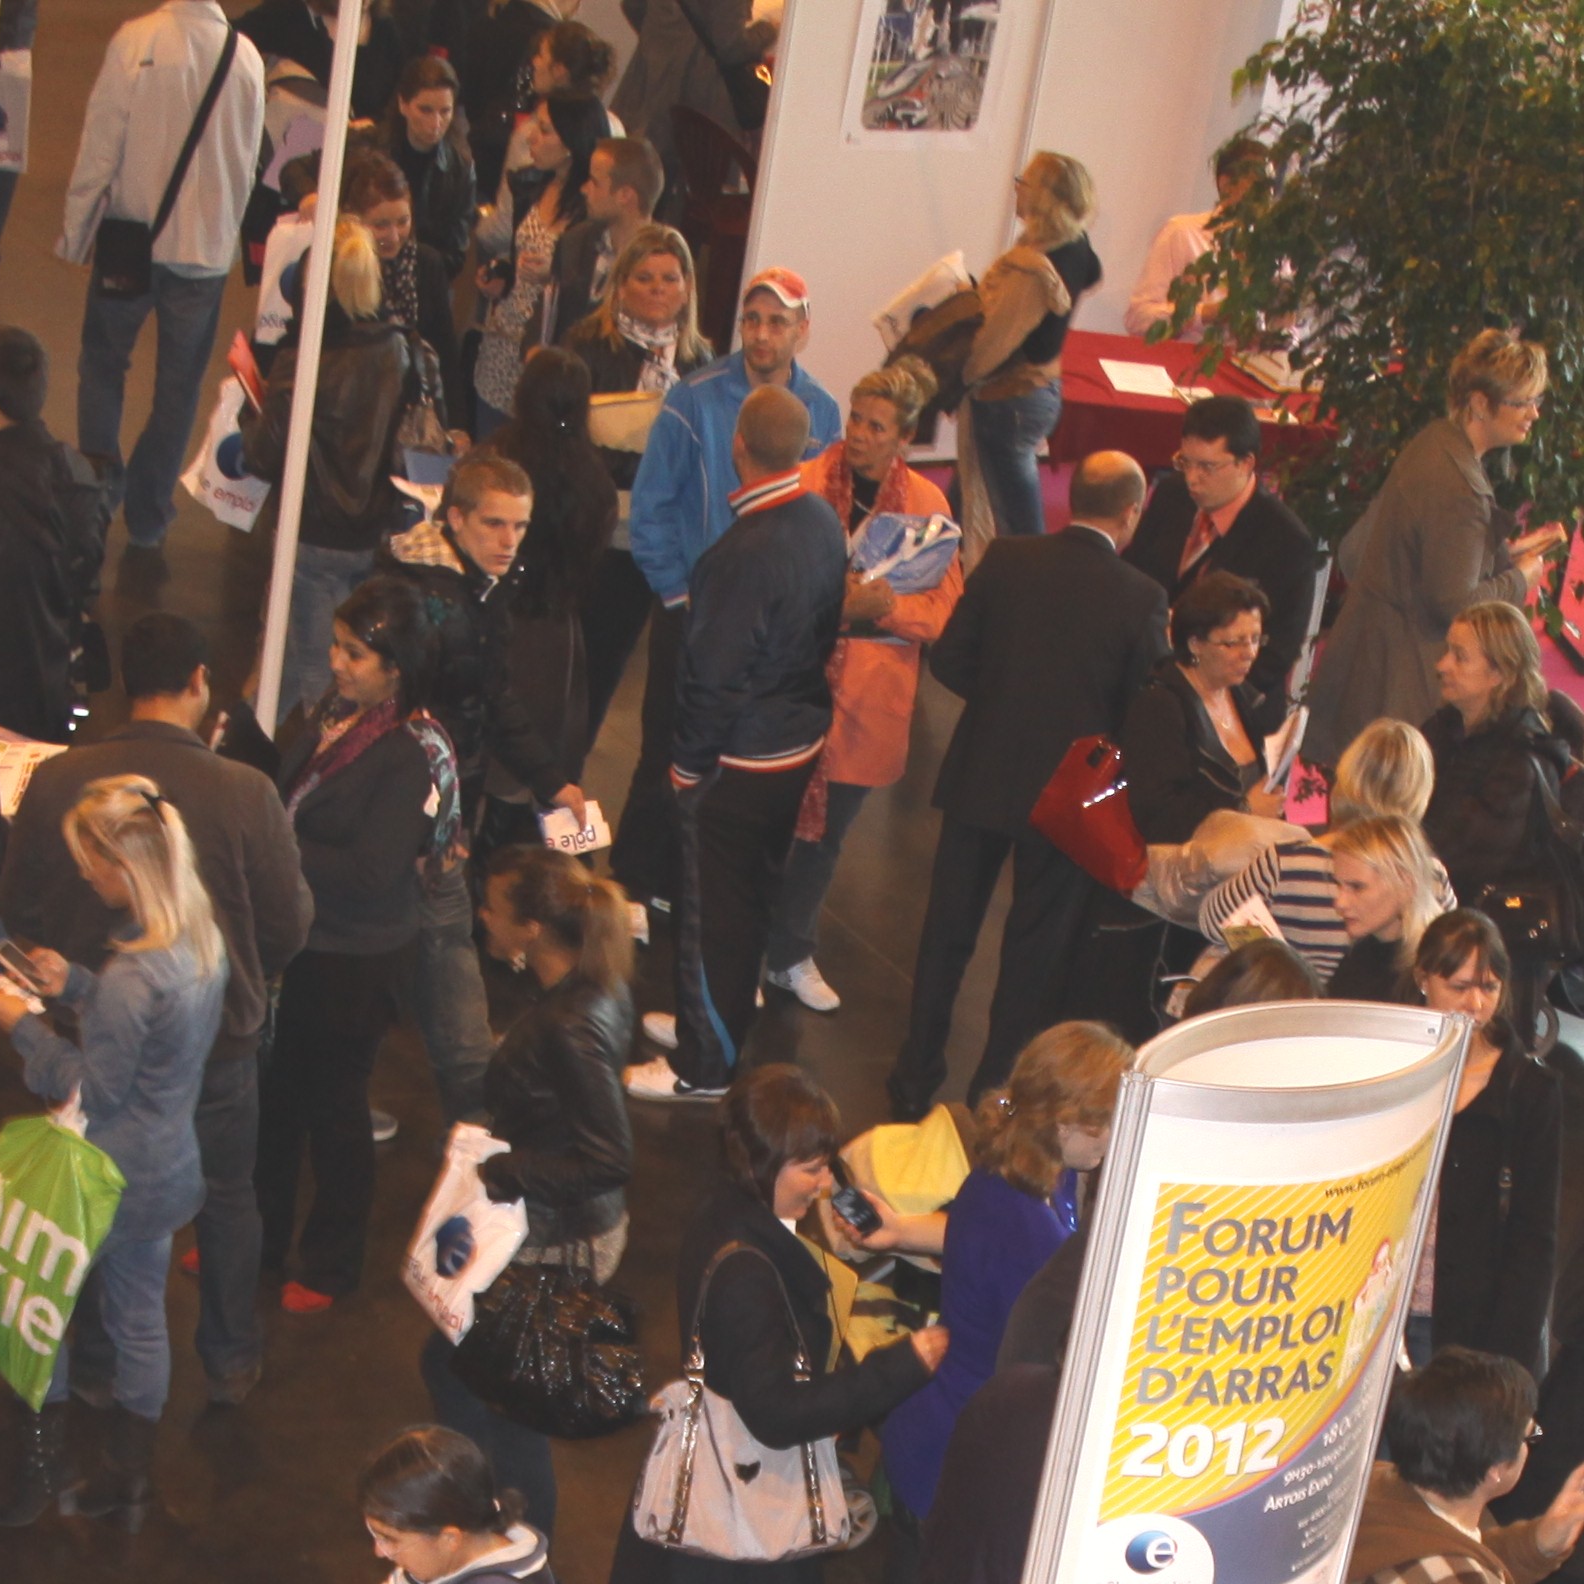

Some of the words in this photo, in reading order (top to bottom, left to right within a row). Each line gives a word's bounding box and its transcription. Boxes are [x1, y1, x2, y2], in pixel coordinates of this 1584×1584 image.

[1165, 1201, 1355, 1259] FORUM
[1154, 1265, 1299, 1308] POUR
[1146, 1300, 1346, 1356] L'EMPLOI
[1135, 1350, 1336, 1408] D'ARRAS
[1119, 1416, 1287, 1480] 2012
